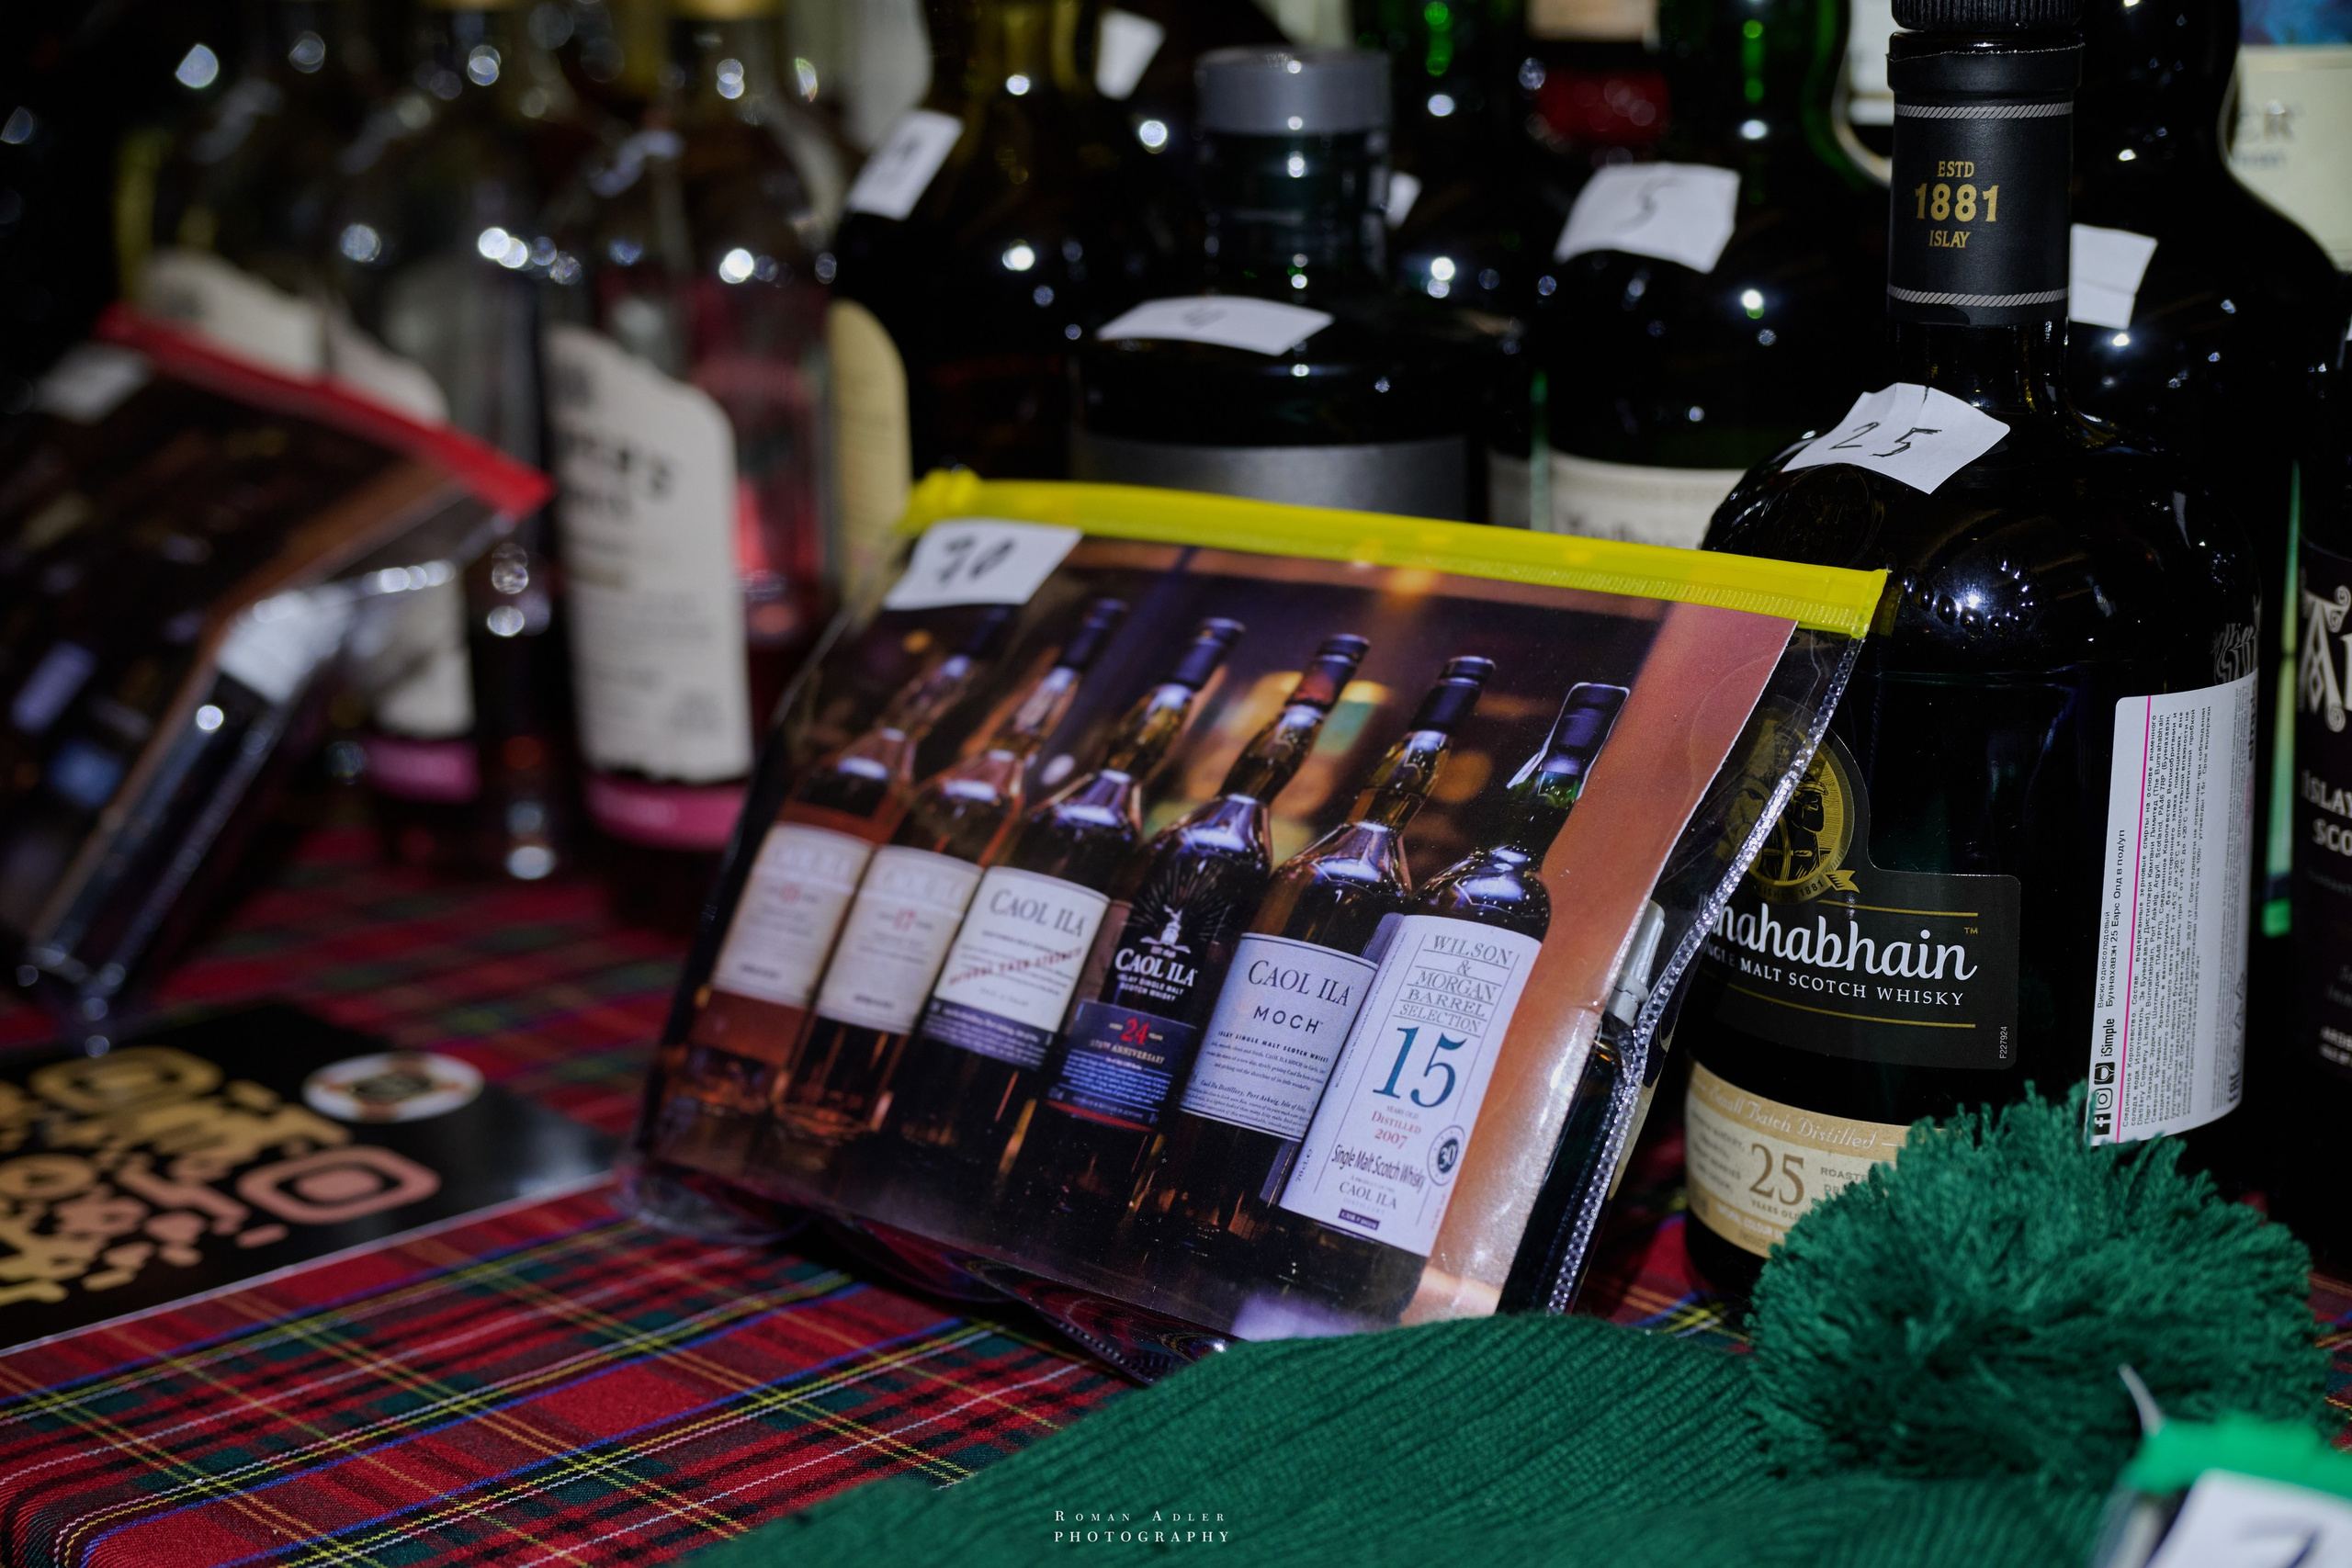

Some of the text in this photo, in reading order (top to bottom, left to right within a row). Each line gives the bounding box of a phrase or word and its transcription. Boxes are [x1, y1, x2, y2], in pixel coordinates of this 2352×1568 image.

[1937, 161, 1974, 178] ESTD
[1915, 184, 1998, 222] 1881
[1928, 230, 1971, 249] ISLAY
[1828, 421, 1941, 457] 25
[2154, 715, 2163, 774] Bunnahabhain
[2188, 709, 2196, 745] пробкой
[2166, 722, 2177, 793] Великобритании
[2184, 750, 2193, 802] герметичной
[2173, 877, 2179, 886] до
[2176, 774, 2185, 837] относительной
[2184, 711, 2189, 721] не
[2150, 801, 2158, 837] Лимитед
[2162, 799, 2172, 853] Королевство
[2312, 818, 2352, 856] SCO
[2115, 829, 2126, 865] под/уп
[2155, 820, 2164, 857] Scotland,
[2181, 844, 2187, 854] до
[1798, 878, 1826, 897] 1881
[2113, 877, 2122, 898] Олд
[2158, 858, 2168, 913] Соединенное
[2179, 882, 2184, 890] от
[989, 888, 1087, 938] CAOL ILA
[2111, 902, 2121, 926] Еарс
[2143, 882, 2153, 933] Дистиллери
[1434, 935, 1513, 964] WILSON
[1713, 902, 1978, 981] nahabhain
[2099, 911, 2110, 980] односолодовый
[2110, 930, 2118, 942] 25
[1114, 947, 1163, 978] CAOL
[1166, 962, 1195, 987] ILA
[1457, 959, 1471, 976] &
[2105, 945, 2118, 1006] Буннахавэн
[2122, 1072, 2132, 1126] Соединенное
[2134, 902, 2144, 961] выдержанные
[2139, 855, 2147, 896] зерновые
[2145, 802, 2150, 812] на
[2139, 937, 2149, 986] Буннахавэн
[2150, 1084, 2159, 1122] Северной
[2167, 827, 2176, 885] постороннего
[1249, 960, 1351, 1007] CAOL ILA
[1415, 970, 1497, 1002] MORGAN
[1741, 957, 1782, 982] MALT
[1788, 972, 1867, 998] SCOTCH
[1877, 987, 1963, 1006] WHISKY
[2138, 991, 2144, 1000] Зе
[1253, 1005, 1320, 1034] MOCH
[1400, 1004, 1481, 1033] SELECTION
[1408, 988, 1486, 1017] BARREL
[1120, 1018, 1149, 1045] 24
[1235, 1034, 1258, 1045] SINGLE
[1262, 1040, 1280, 1050] MALT
[1283, 1045, 1308, 1057] SCOTCH
[1999, 1026, 2008, 1059] F227924
[2101, 1018, 2116, 1056] iSimple
[1373, 1026, 1467, 1108] 15
[2139, 1050, 2148, 1086] Company
[1746, 1100, 1792, 1134] Batch
[1797, 1116, 1879, 1149] Distilled
[2136, 1091, 2145, 1124] Distillery
[1374, 1128, 1408, 1149] 2007
[1332, 1144, 1356, 1170] Single
[1354, 1150, 1374, 1173] Malt
[1372, 1156, 1401, 1183] Scotch
[1399, 1163, 1427, 1194] Whisky
[1749, 1143, 1805, 1206] 25
[1820, 1167, 1869, 1181] ROASTE
[1339, 1181, 1373, 1203] CAOL
[1375, 1191, 1397, 1210] ILA
[1751, 1200, 1800, 1222] YEARS OLD
